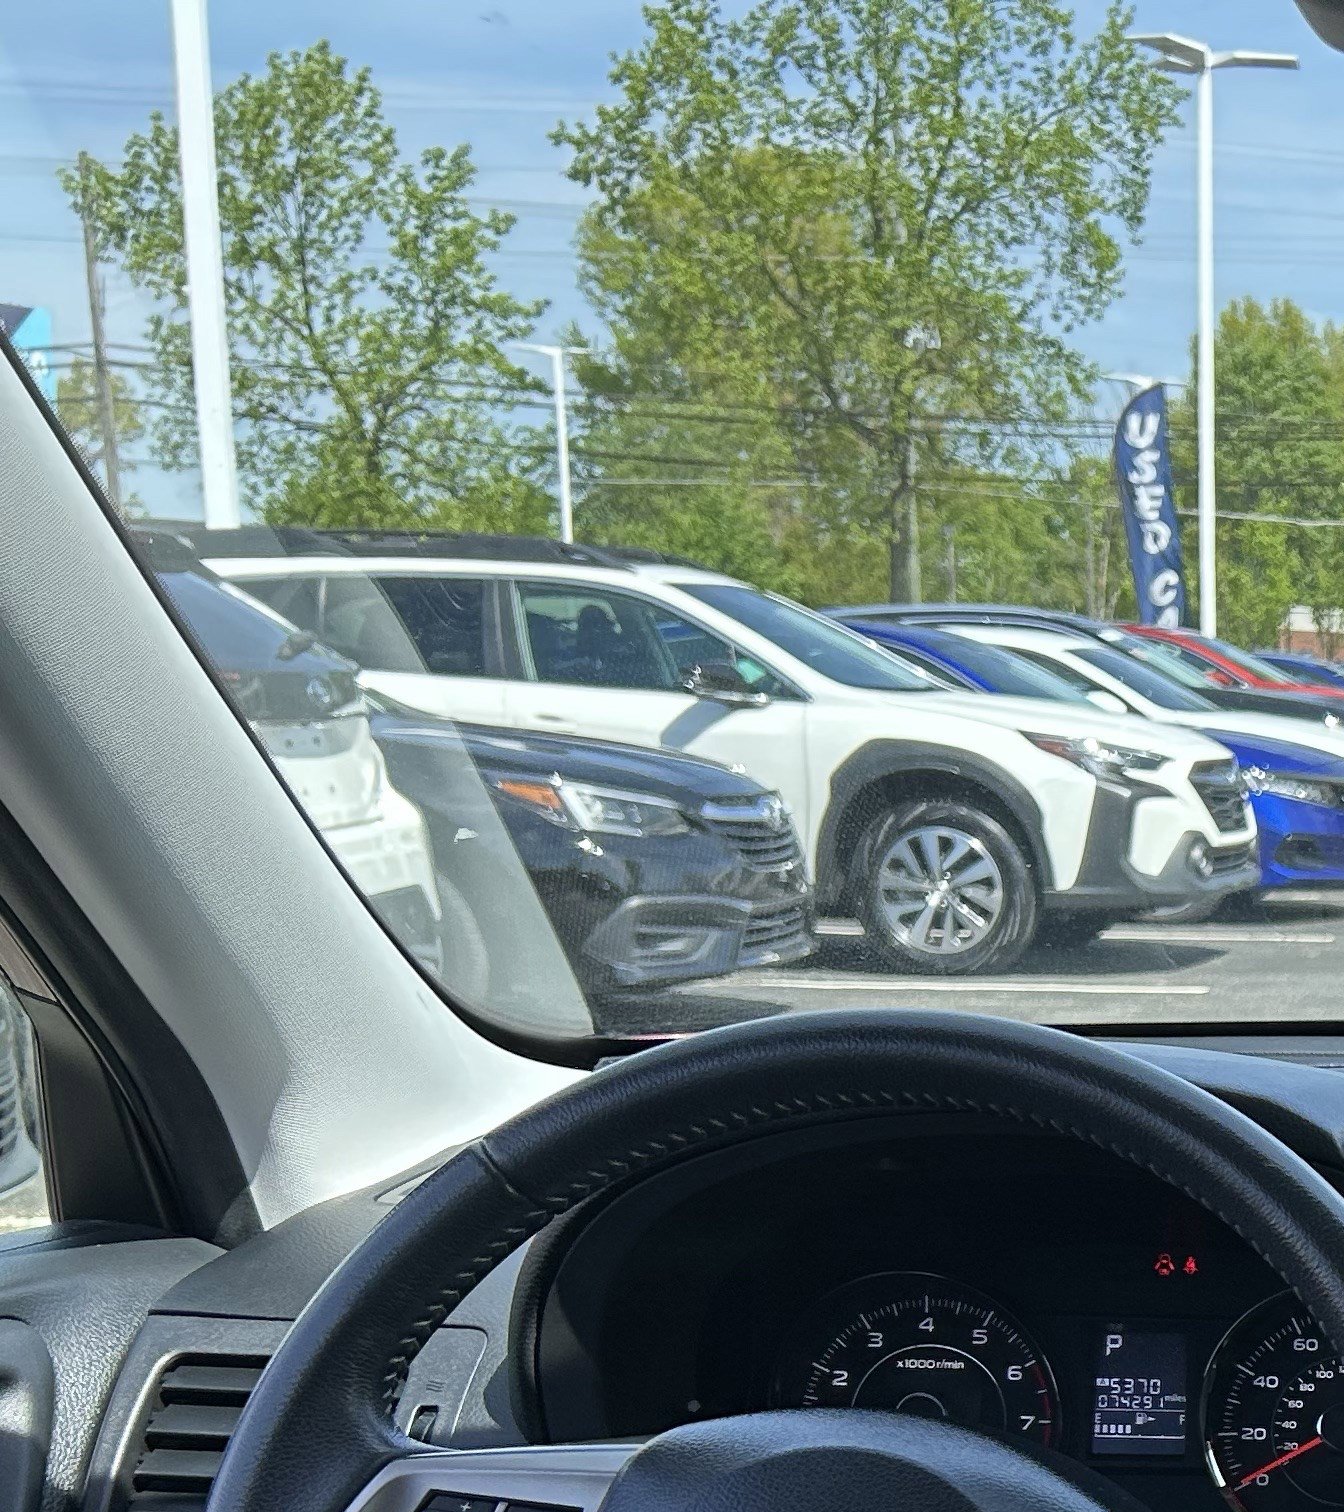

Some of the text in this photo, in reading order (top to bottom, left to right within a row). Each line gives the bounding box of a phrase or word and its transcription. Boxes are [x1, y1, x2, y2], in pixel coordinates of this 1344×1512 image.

[1123, 412, 1171, 555] USED
[918, 1317, 934, 1332] 4
[867, 1332, 883, 1348] 3
[972, 1329, 988, 1345] 5
[1106, 1334, 1123, 1356] P
[1293, 1338, 1319, 1351] 60
[832, 1370, 848, 1386] 2
[1007, 1365, 1023, 1381] 6
[1315, 1370, 1334, 1379] 100
[1110, 1378, 1161, 1395] 5370
[1253, 1375, 1279, 1388] 40
[1299, 1383, 1315, 1392] 80
[1098, 1395, 1164, 1409] 074291
[1288, 1400, 1304, 1409] 60
[1020, 1415, 1036, 1431] 7
[1094, 1412, 1186, 1425] E F
[1281, 1420, 1298, 1429] 40
[1241, 1427, 1267, 1440] 20
[1283, 1442, 1299, 1450] 20
[1256, 1474, 1270, 1486] 0
